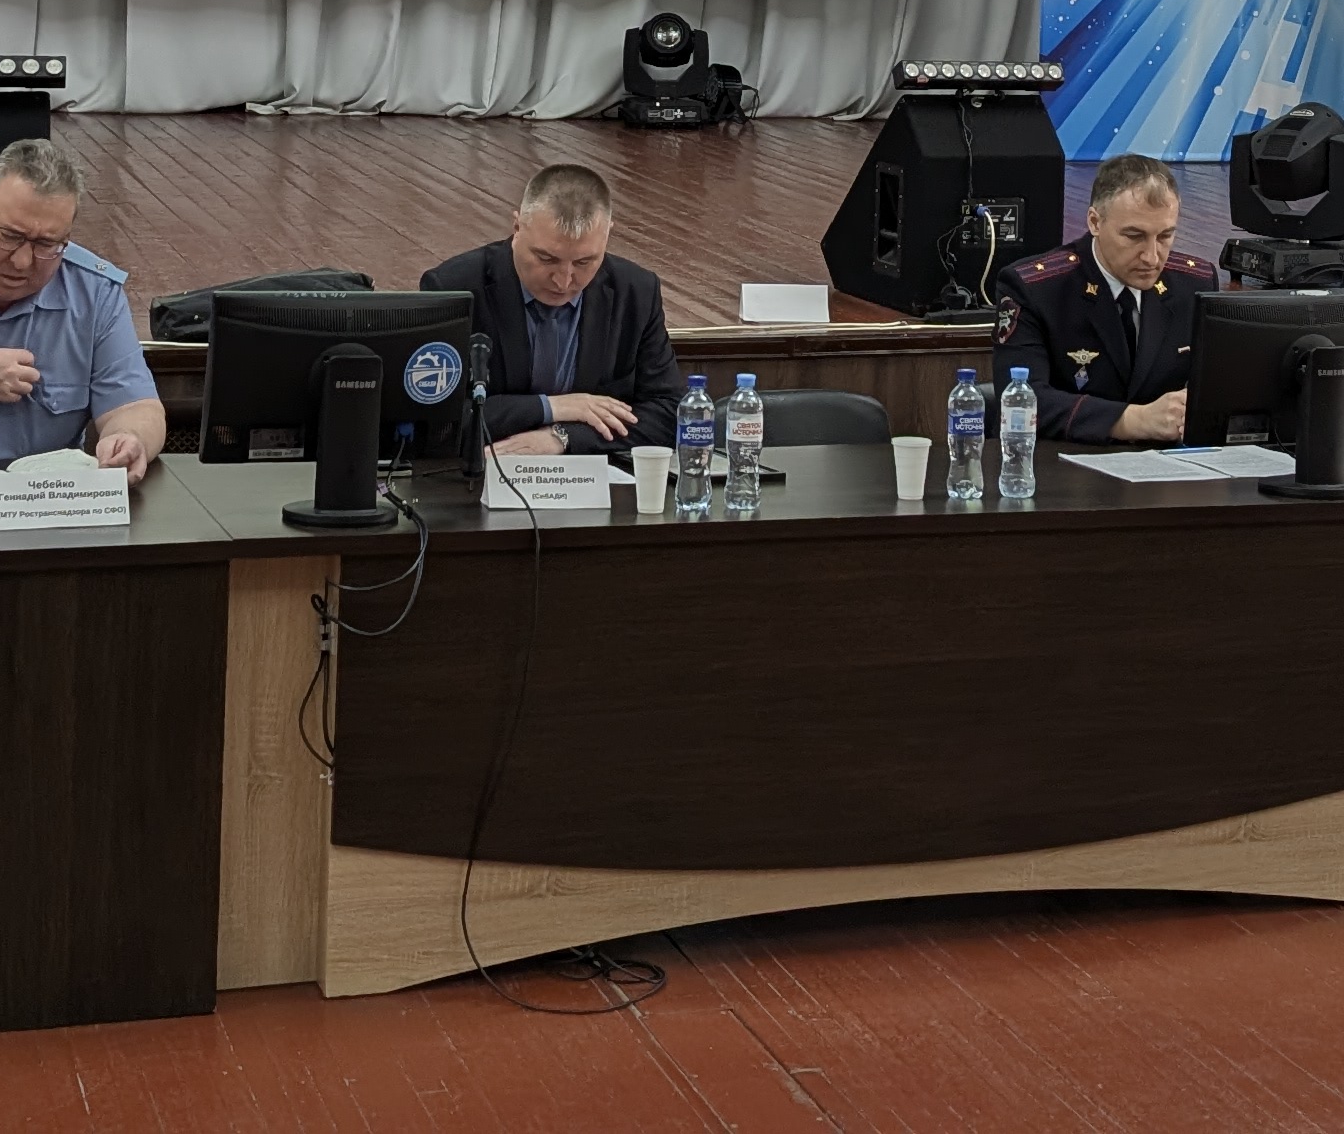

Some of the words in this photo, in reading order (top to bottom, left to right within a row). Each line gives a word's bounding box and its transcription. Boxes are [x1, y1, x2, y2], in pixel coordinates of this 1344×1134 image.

[335, 380, 377, 389] SAMSUNG
[514, 465, 565, 474] Савельев
[28, 479, 75, 490] Чебейко
[536, 476, 595, 485] Валерьевич
[48, 490, 123, 501] Владимирович
[104, 506, 127, 515] СФО)
